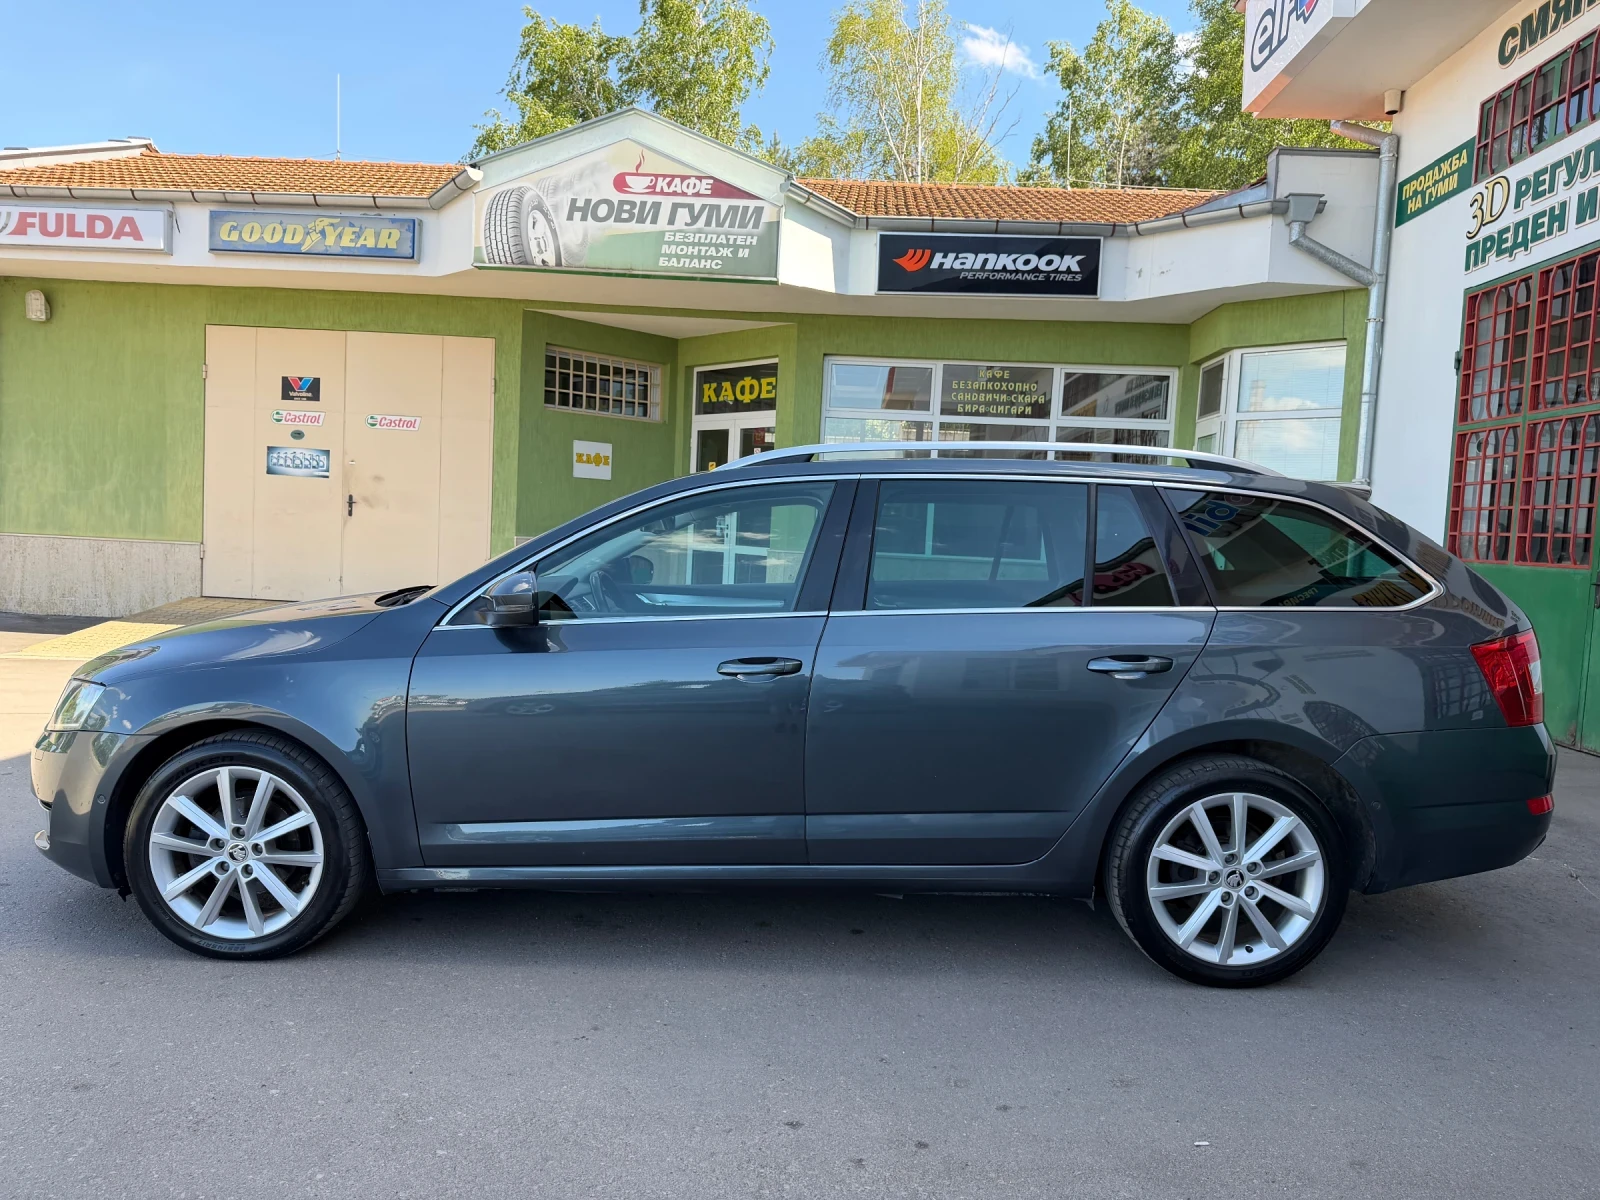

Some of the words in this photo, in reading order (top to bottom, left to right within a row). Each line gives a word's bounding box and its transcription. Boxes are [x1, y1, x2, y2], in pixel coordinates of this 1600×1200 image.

[1498, 0, 1600, 67] СМЯ
[1402, 149, 1468, 200] ПРОДАЖБА
[655, 176, 714, 196] КАФЕ
[1407, 194, 1422, 214] НА
[1425, 172, 1458, 204] ГУМИ
[566, 197, 661, 225] НОВИ
[667, 202, 765, 230] ГУМИ
[1466, 176, 1510, 239] 3D
[6, 212, 144, 242] FULDA
[1464, 197, 1570, 273] ПРЕДЕН
[1575, 184, 1600, 228] И
[663, 232, 758, 246] БЕЗПЛАТЕН
[661, 245, 734, 258] МОНТАЖ
[737, 248, 750, 258] И
[658, 257, 723, 270] БАЛАНС
[959, 271, 1047, 281] PERFORMANCE
[1049, 273, 1082, 282] TIRES
[979, 369, 1011, 379] КАФЕ
[703, 376, 776, 403] КАФЕ
[1011, 394, 1045, 404] СКАРА
[957, 404, 985, 413] БИРА
[989, 405, 1032, 415] ЦИГАРИ
[284, 412, 321, 424] Castrol
[379, 416, 417, 429] Castrol
[576, 452, 610, 467] КАФЕ
